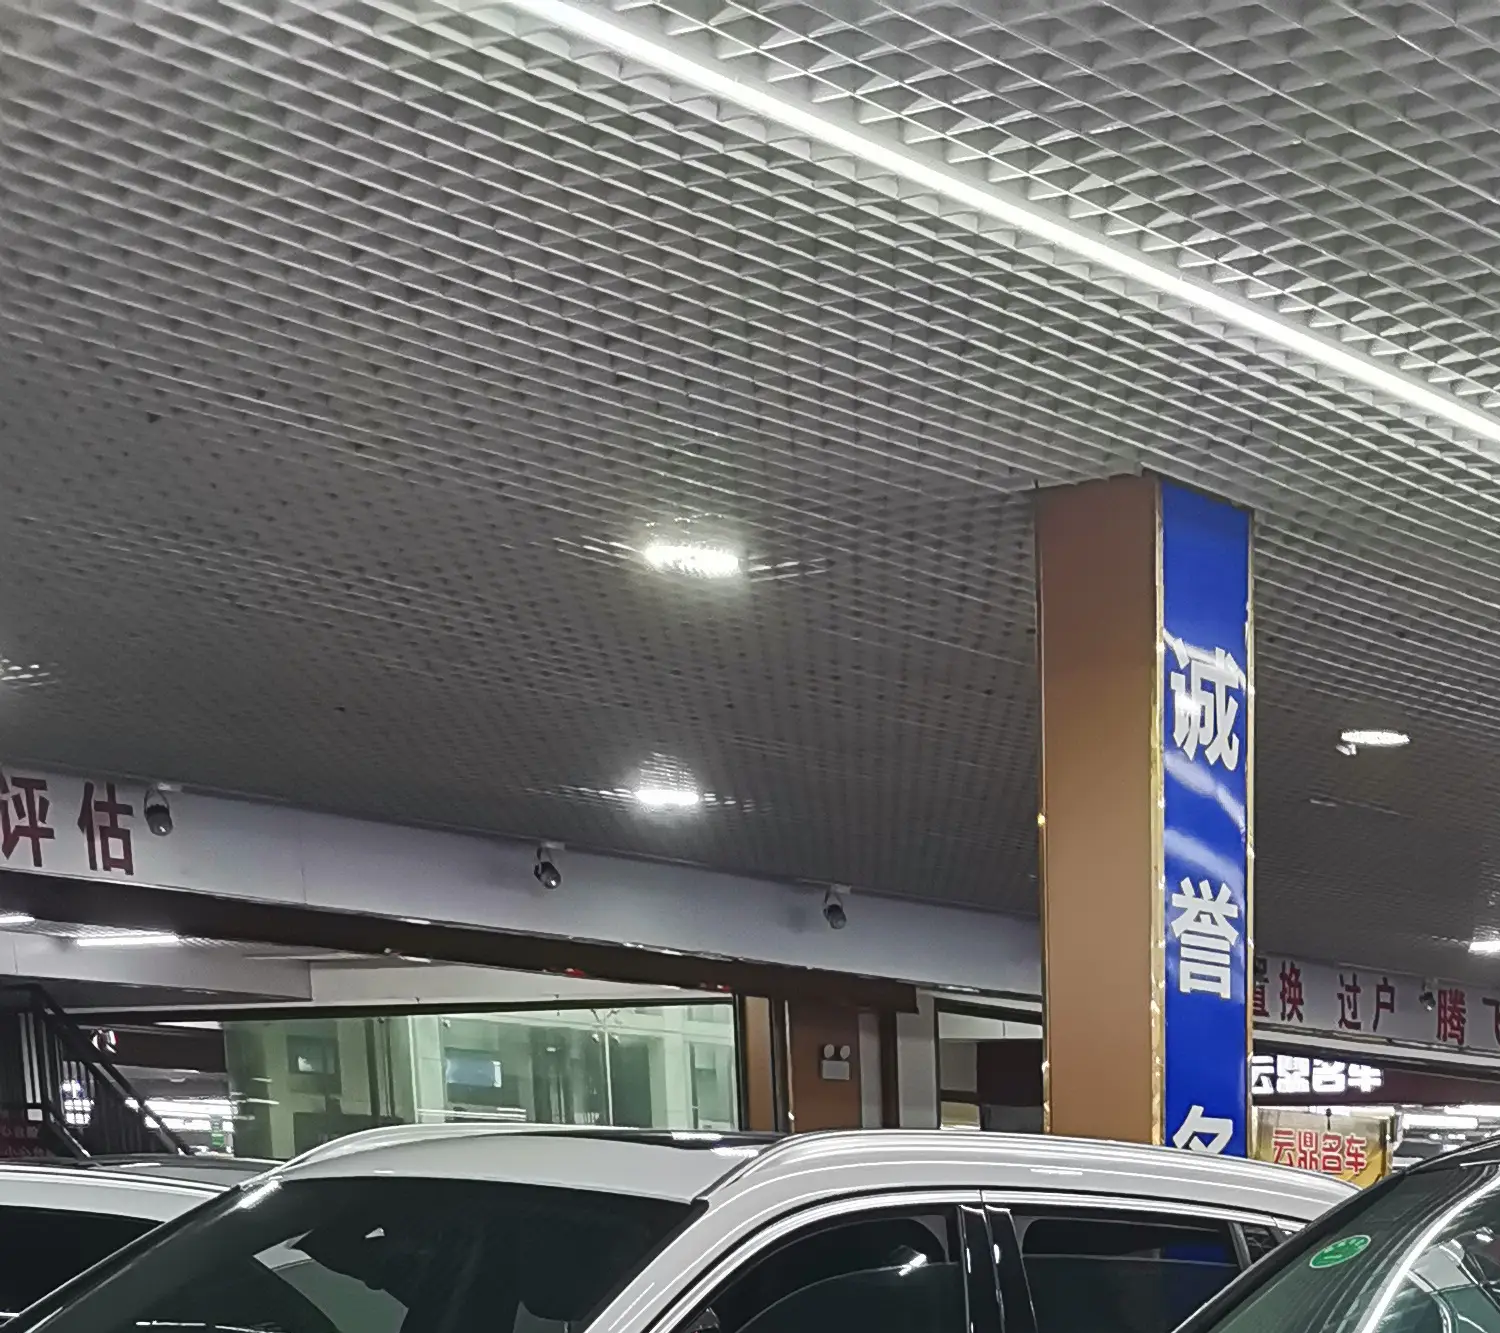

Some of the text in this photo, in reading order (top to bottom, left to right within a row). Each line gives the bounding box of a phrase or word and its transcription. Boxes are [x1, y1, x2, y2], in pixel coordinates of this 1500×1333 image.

[0, 766, 134, 875] 评估
[1337, 973, 1395, 1032] 过户
[1272, 1128, 1367, 1174] 云鼎名车
